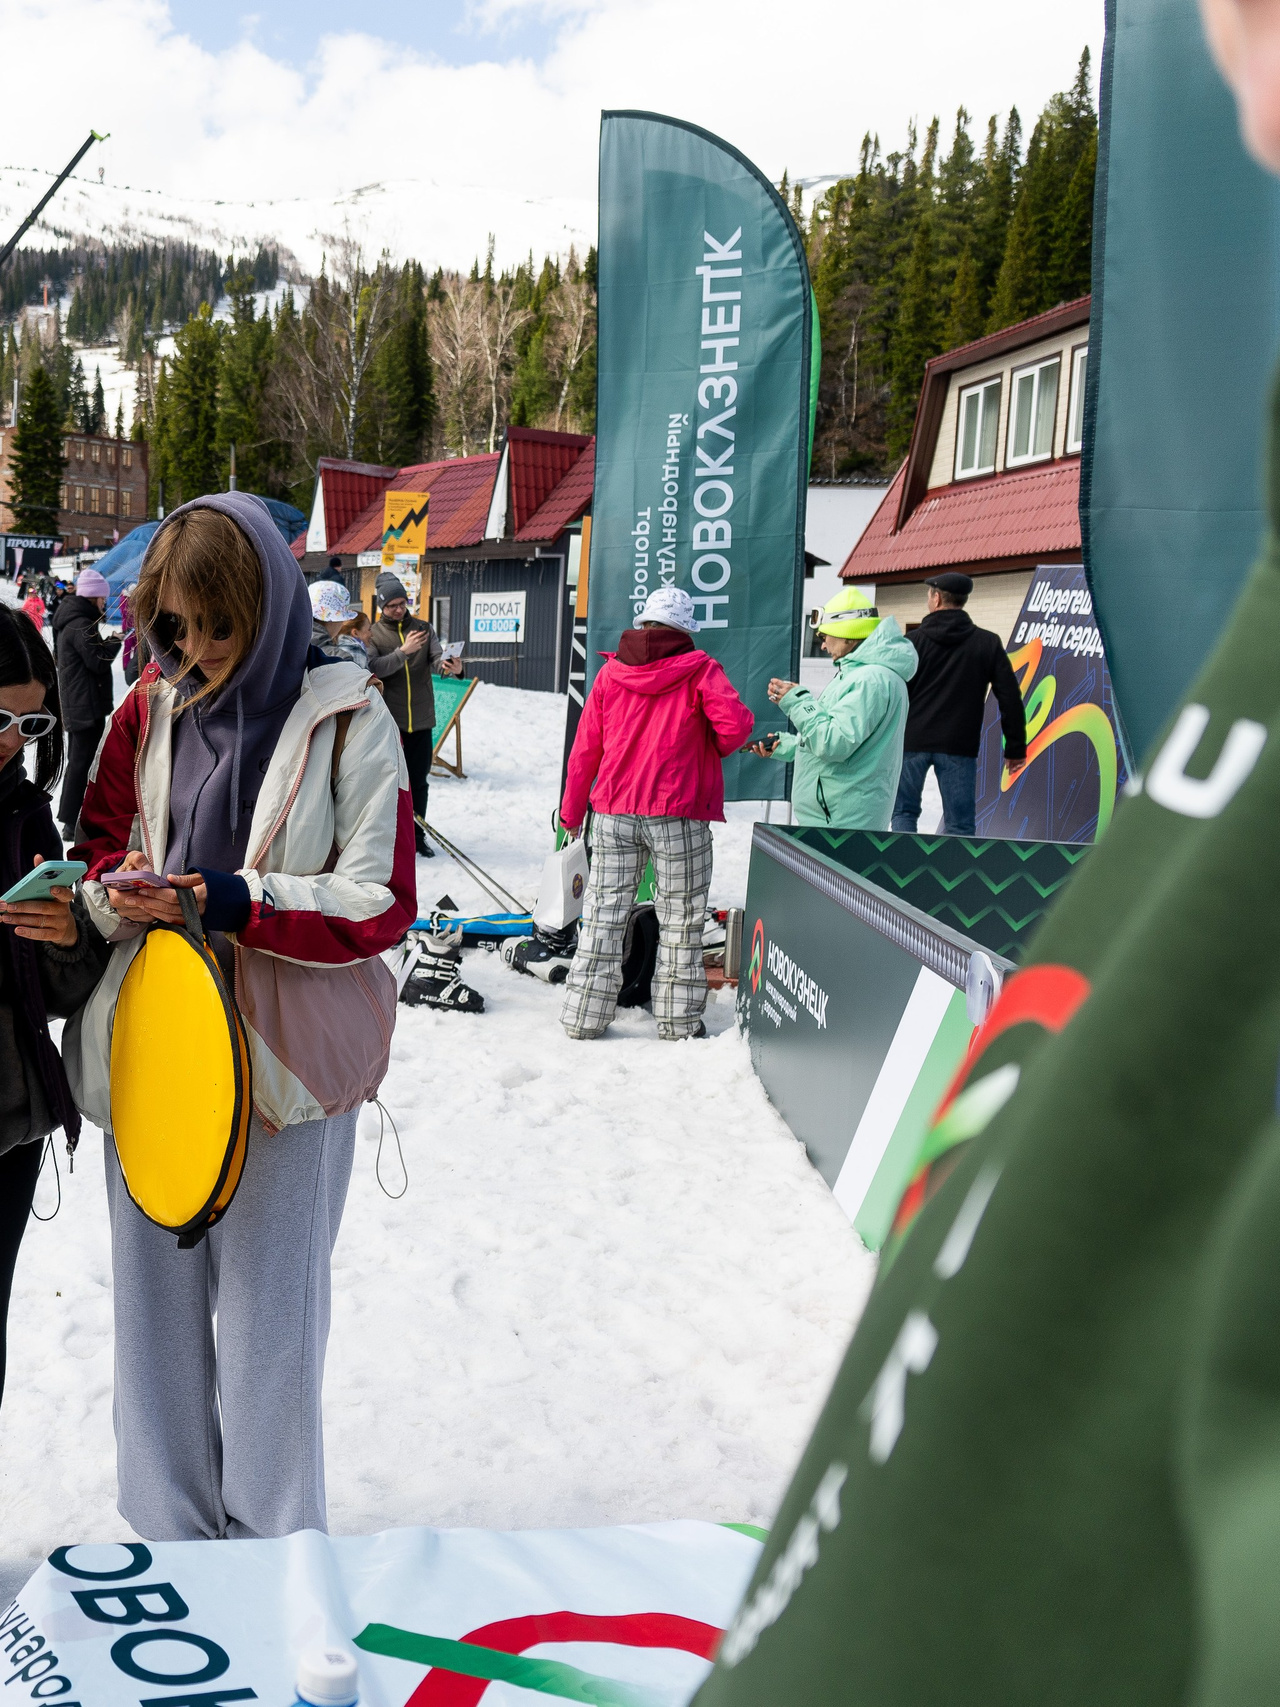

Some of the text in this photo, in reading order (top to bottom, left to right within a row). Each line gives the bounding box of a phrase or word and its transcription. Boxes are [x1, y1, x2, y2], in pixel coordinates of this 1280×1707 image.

[6, 538, 53, 549] ПРОКАТ
[474, 602, 521, 616] ПРОКАТ
[477, 620, 492, 631] ОТ
[1014, 621, 1029, 643] в
[1025, 616, 1066, 648] моём
[767, 939, 829, 1030] НОВОКУЗНЕЦК
